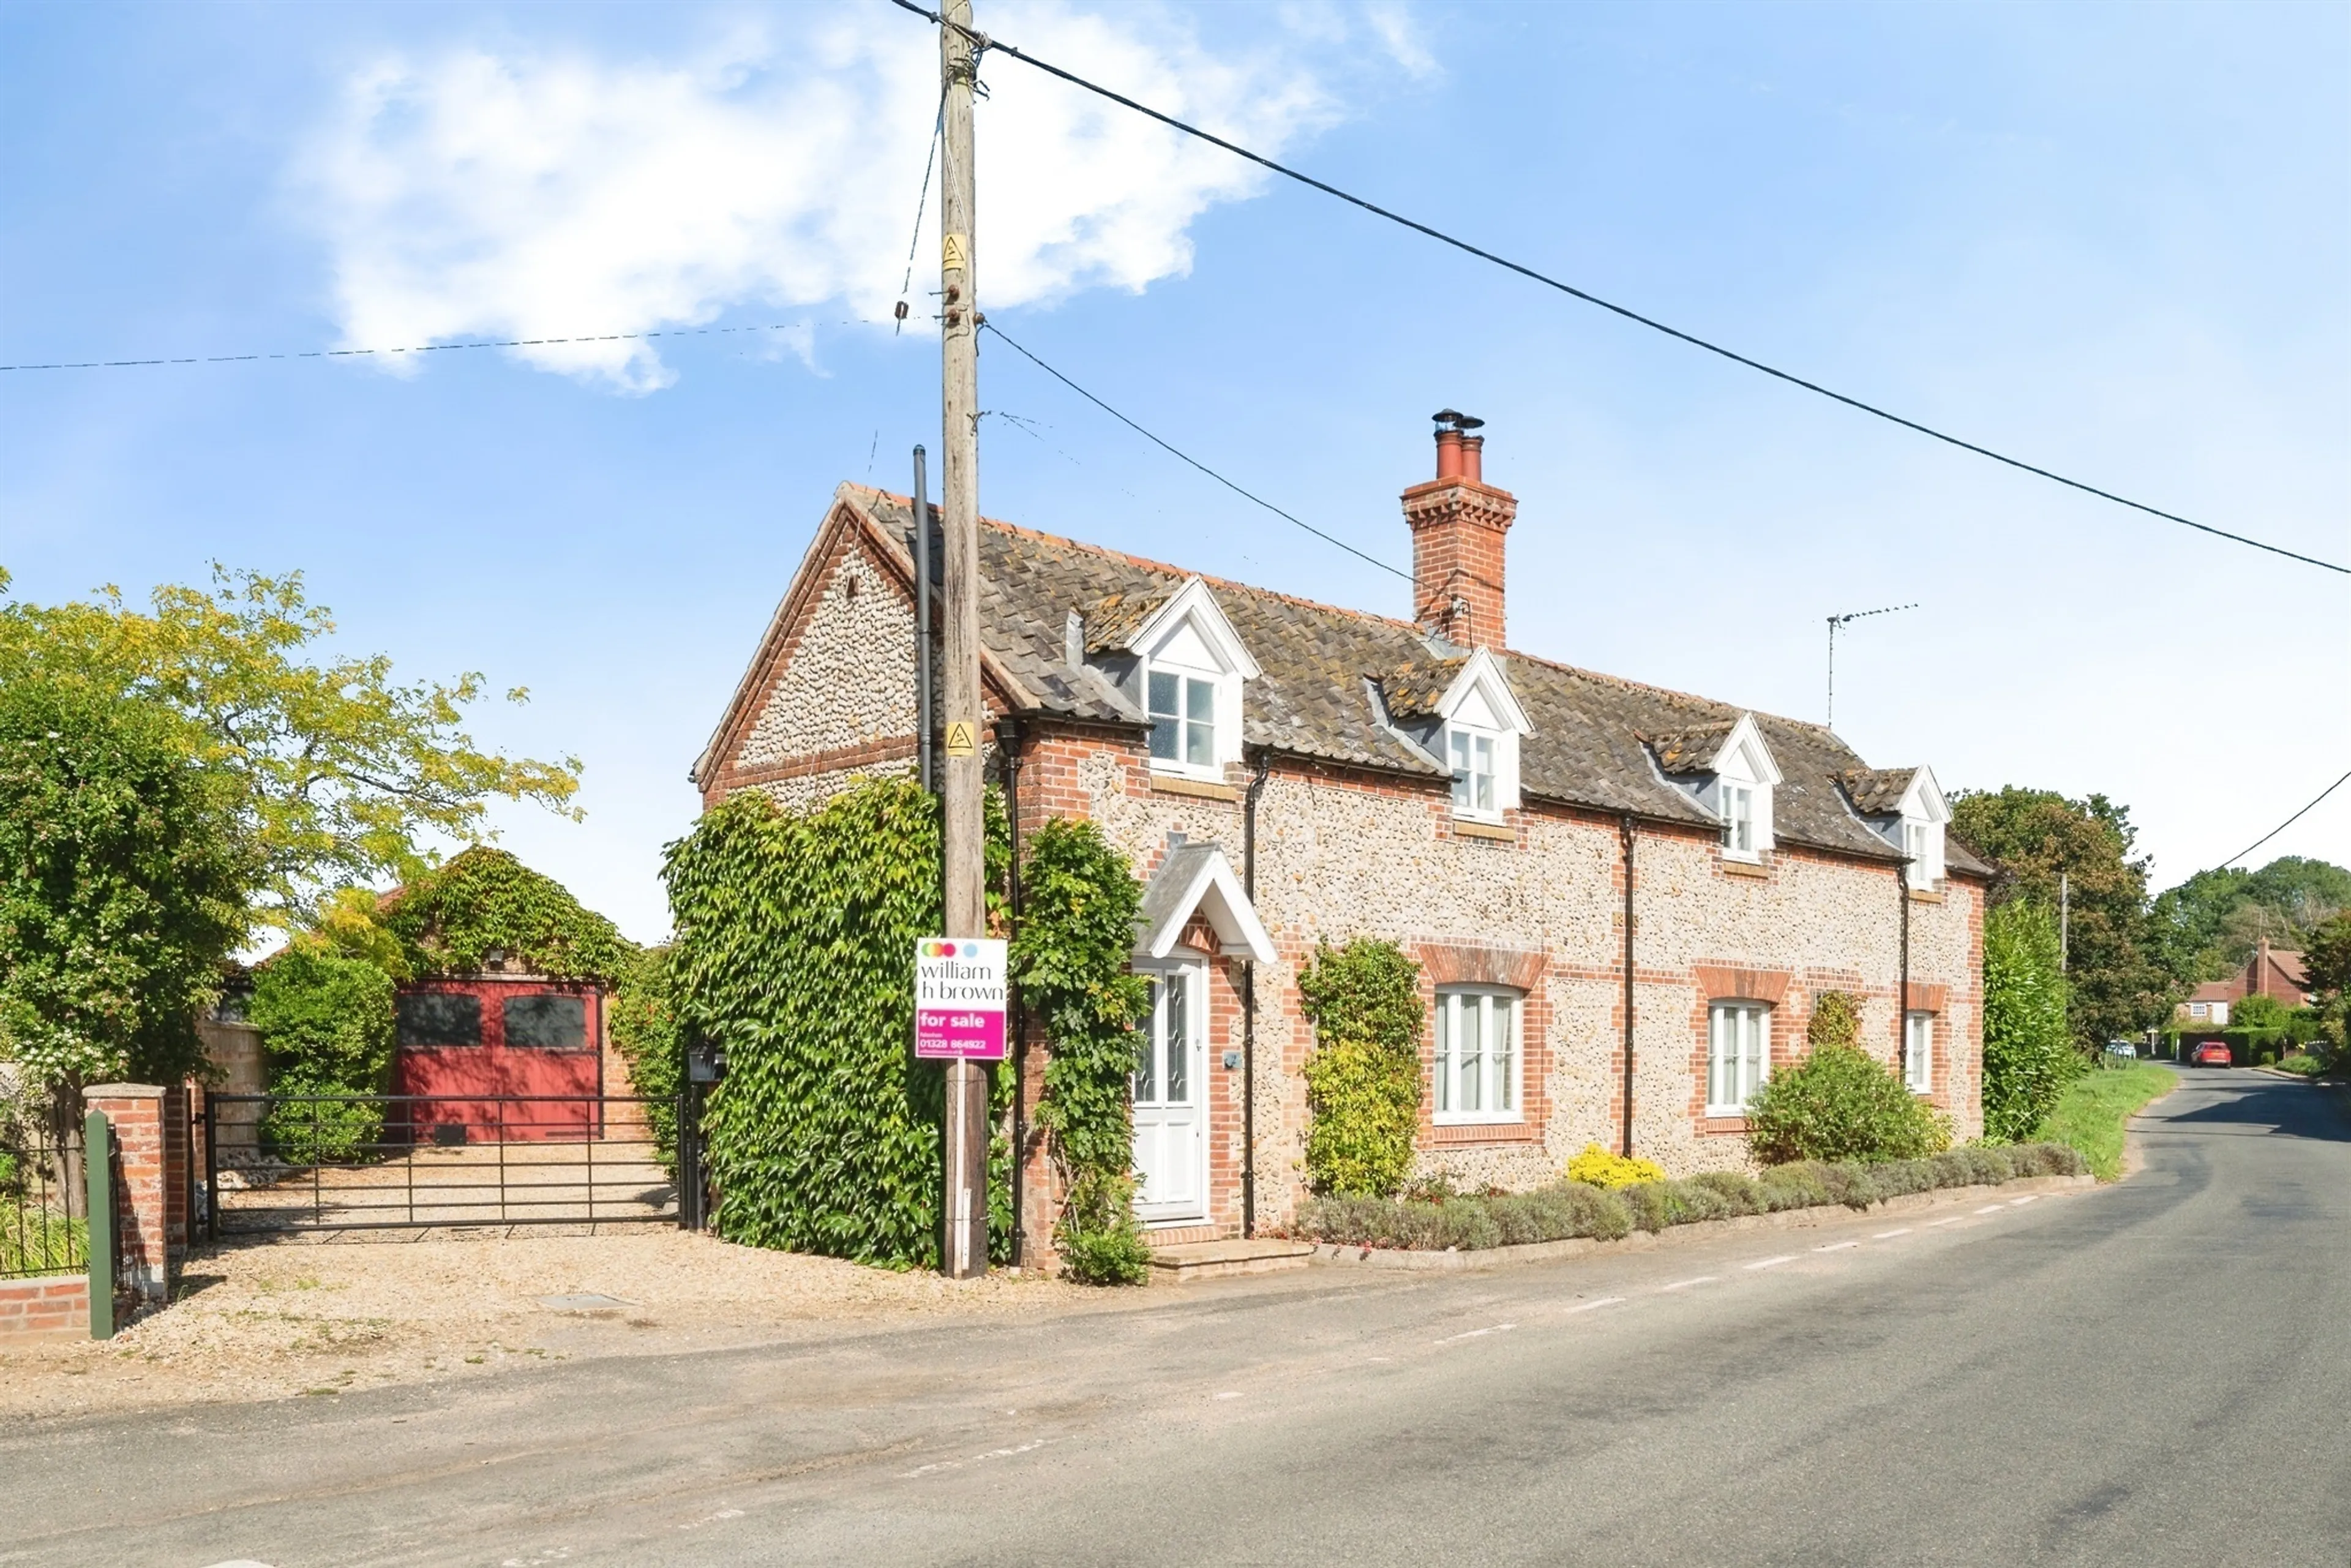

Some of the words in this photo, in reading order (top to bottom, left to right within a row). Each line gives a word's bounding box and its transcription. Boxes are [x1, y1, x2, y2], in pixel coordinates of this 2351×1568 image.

[921, 961, 991, 980] william
[923, 981, 934, 999] h
[940, 981, 1003, 1000] brown
[920, 1012, 946, 1027] for
[950, 1013, 985, 1028] sale
[920, 1039, 948, 1048] 01328
